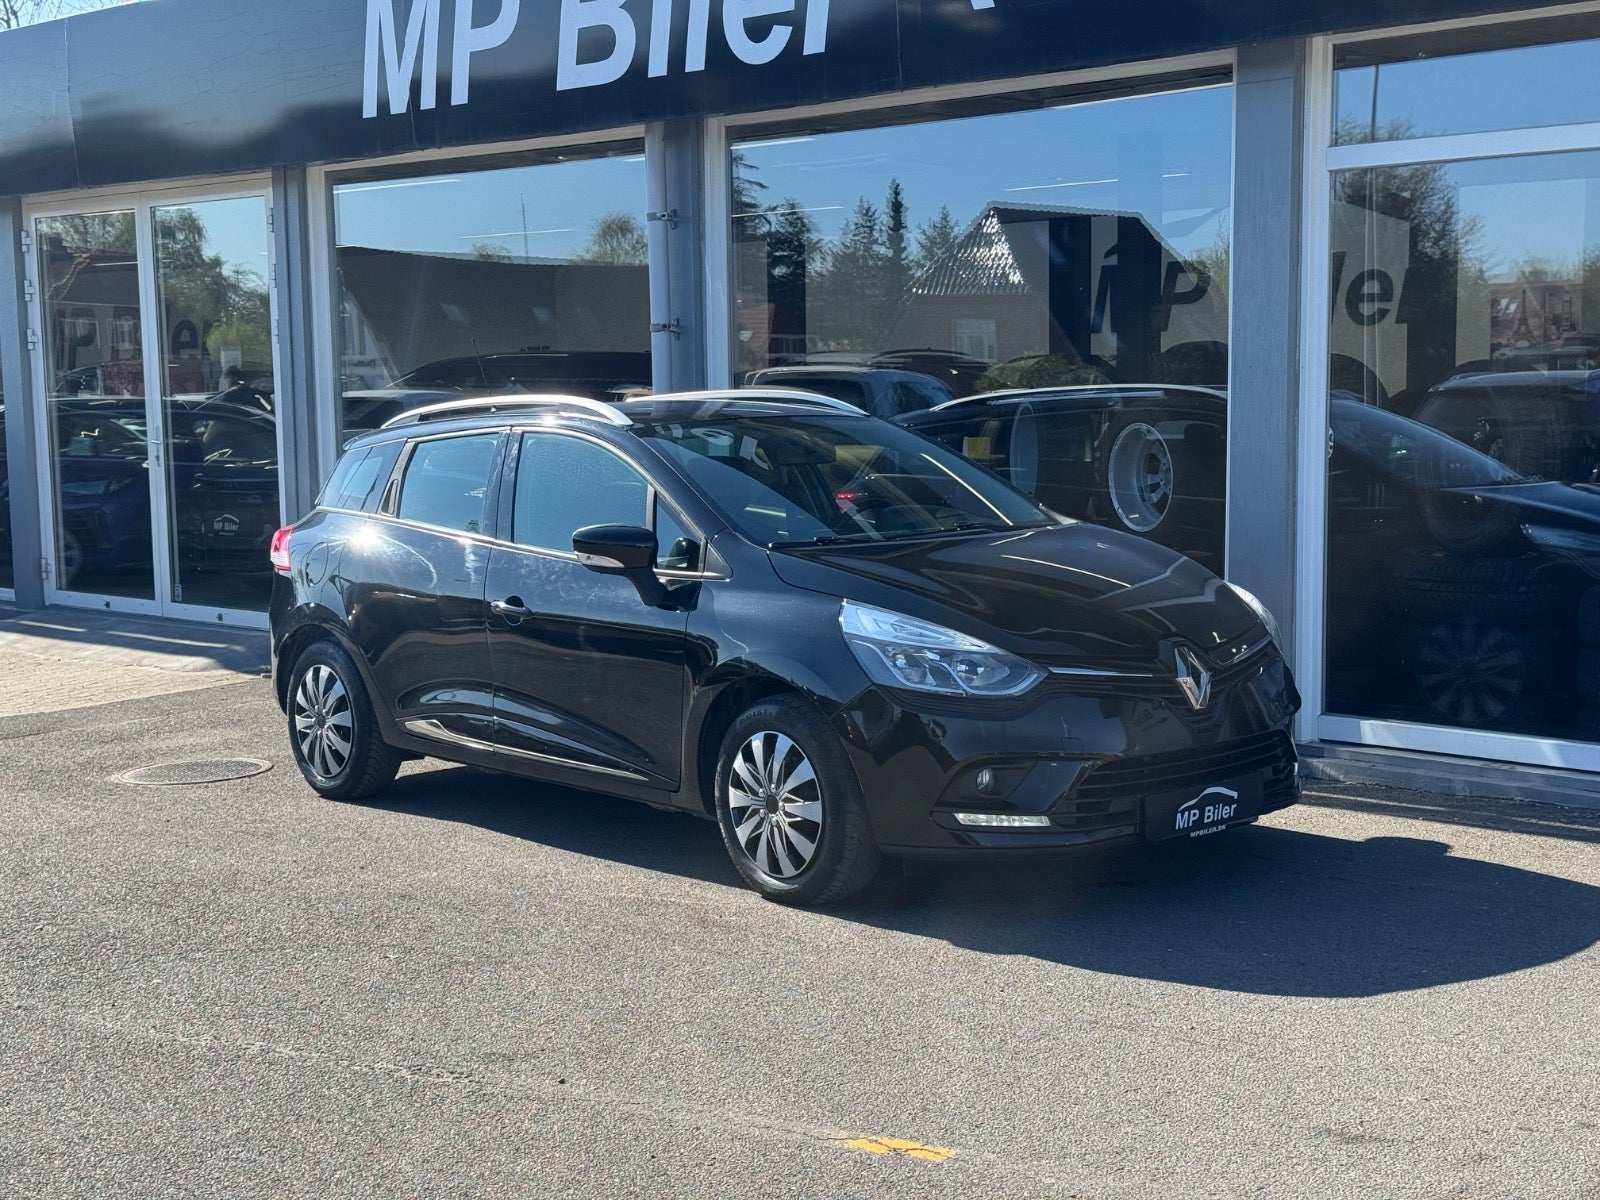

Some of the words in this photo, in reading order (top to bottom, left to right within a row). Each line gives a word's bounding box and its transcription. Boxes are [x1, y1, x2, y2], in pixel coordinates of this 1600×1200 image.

[362, 0, 520, 118] MP
[1175, 809, 1200, 830] MP
[1203, 803, 1238, 824] Biler
